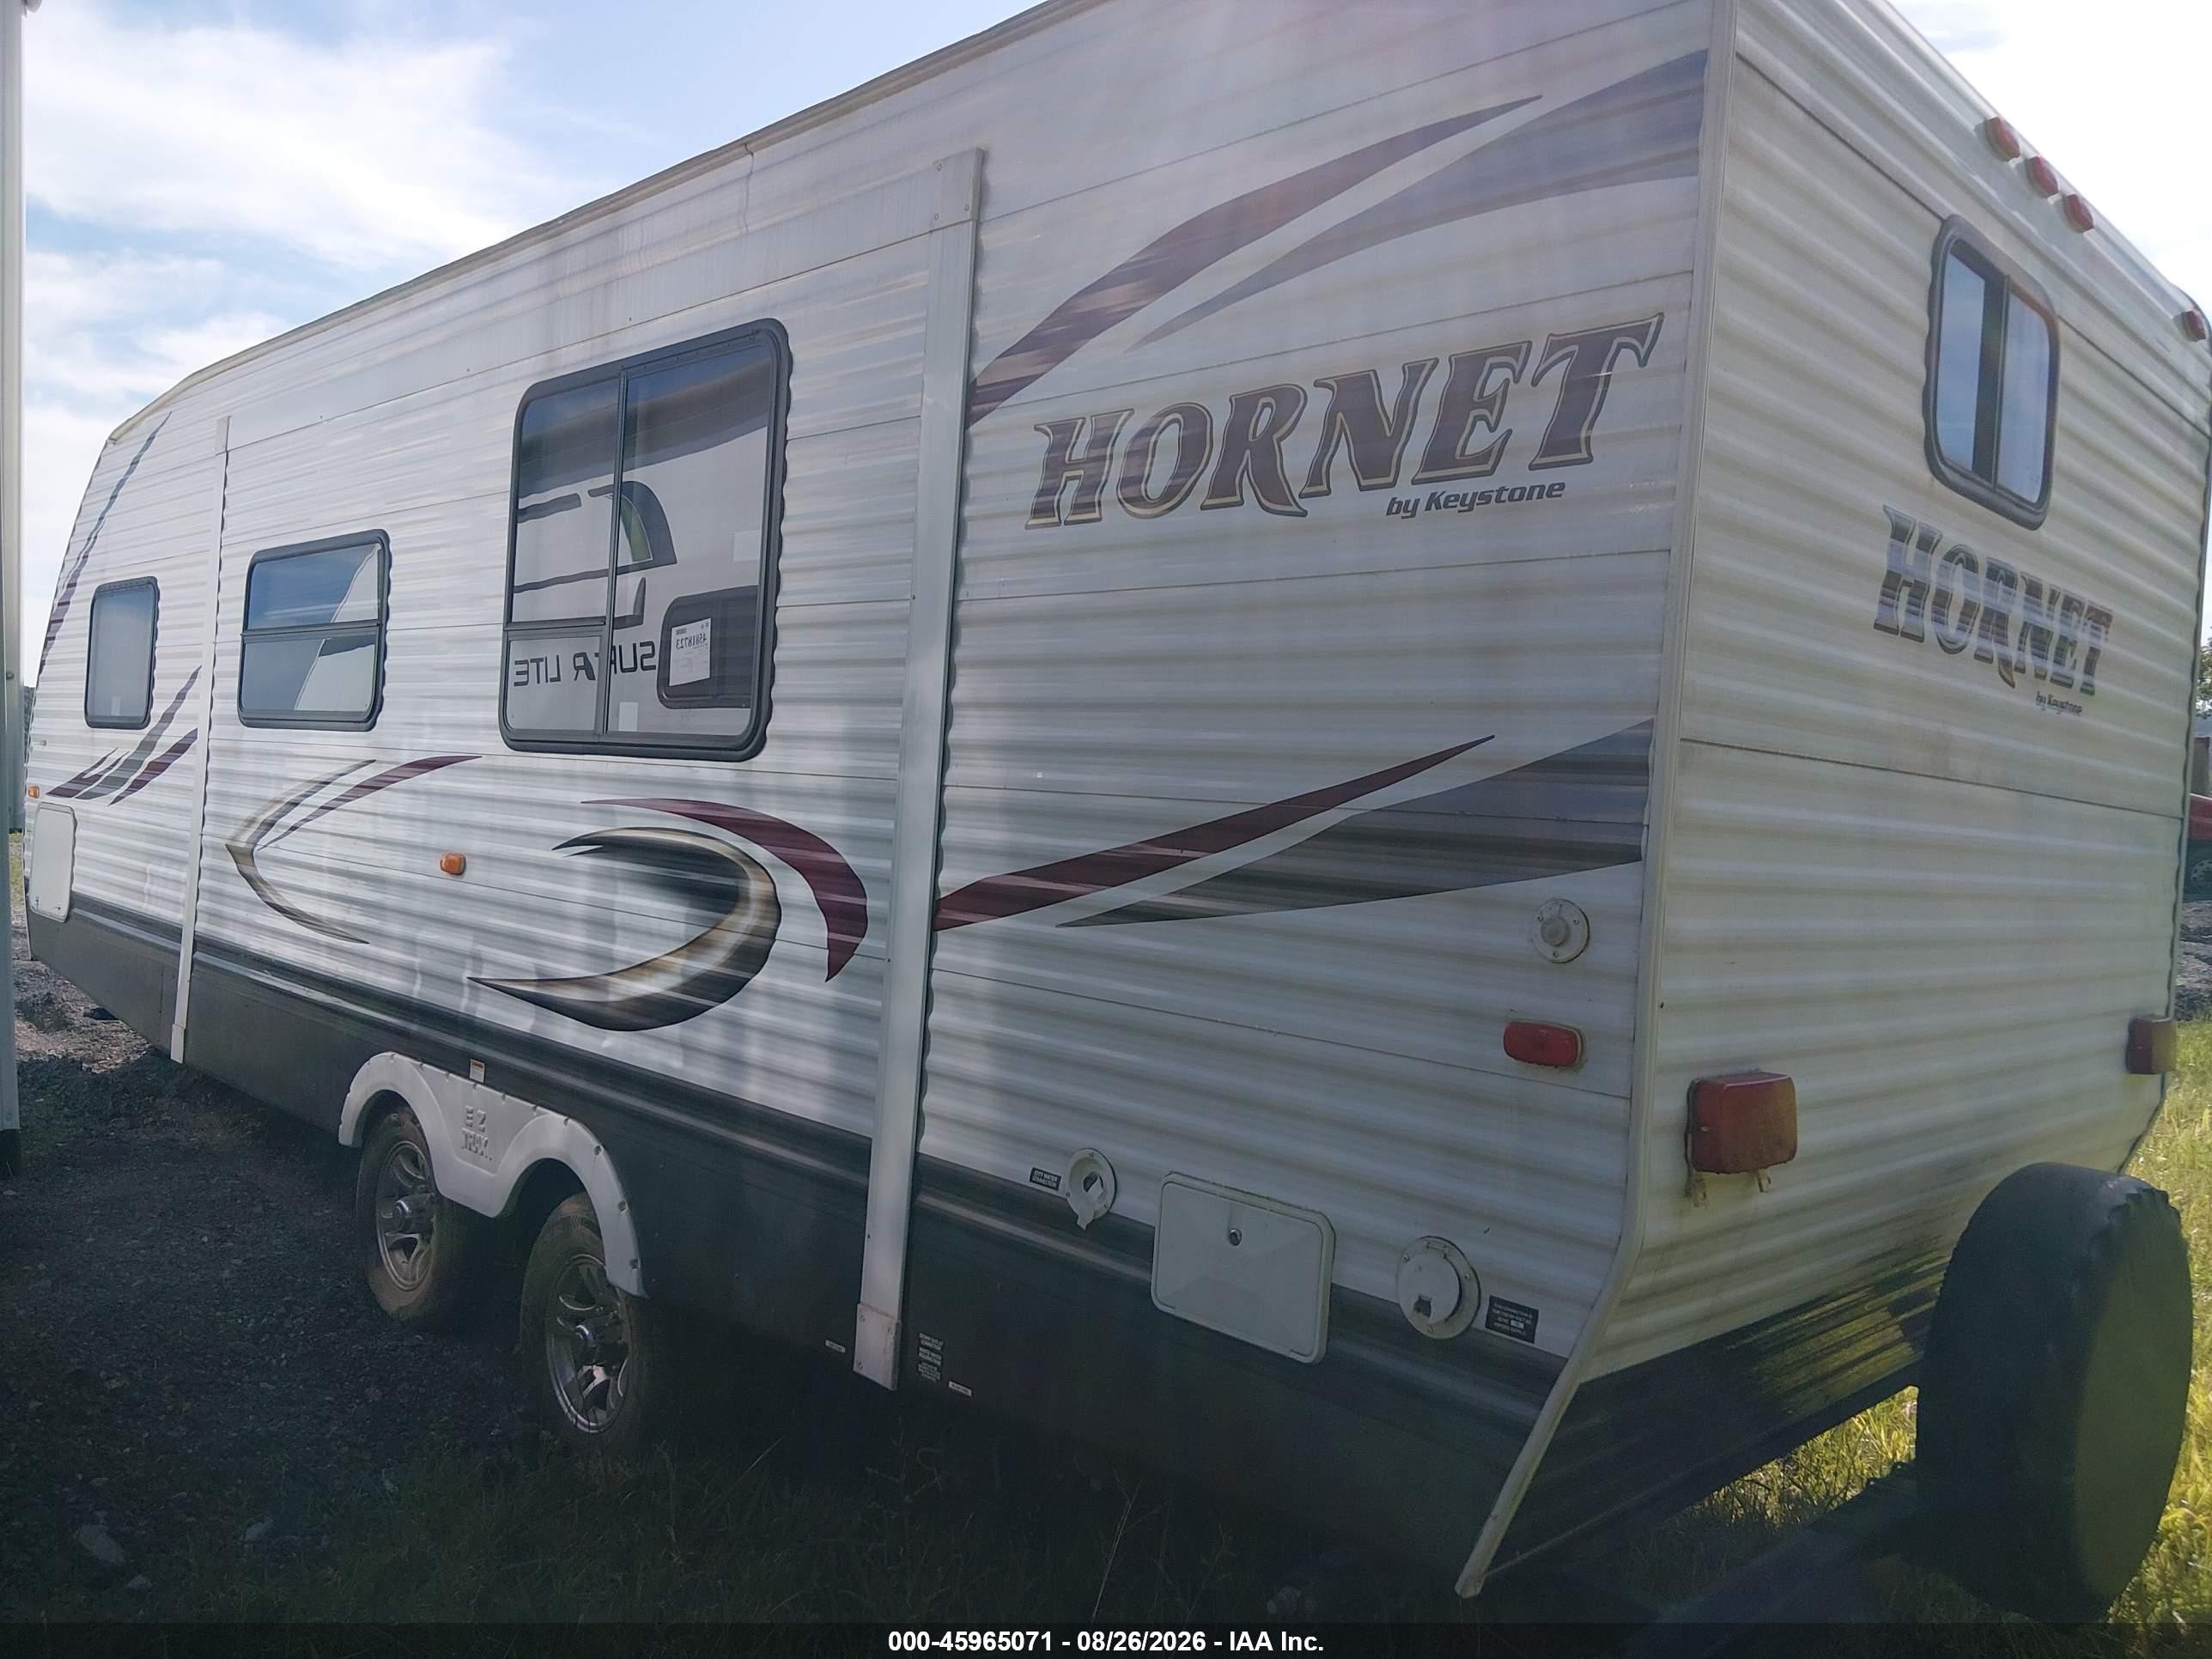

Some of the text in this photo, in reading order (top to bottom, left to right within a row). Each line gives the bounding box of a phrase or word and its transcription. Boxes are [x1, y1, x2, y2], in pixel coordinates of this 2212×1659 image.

[1024, 312, 1665, 529] HORNET
[1386, 482, 1566, 520] by Keystone
[1873, 504, 2114, 696] HORNET
